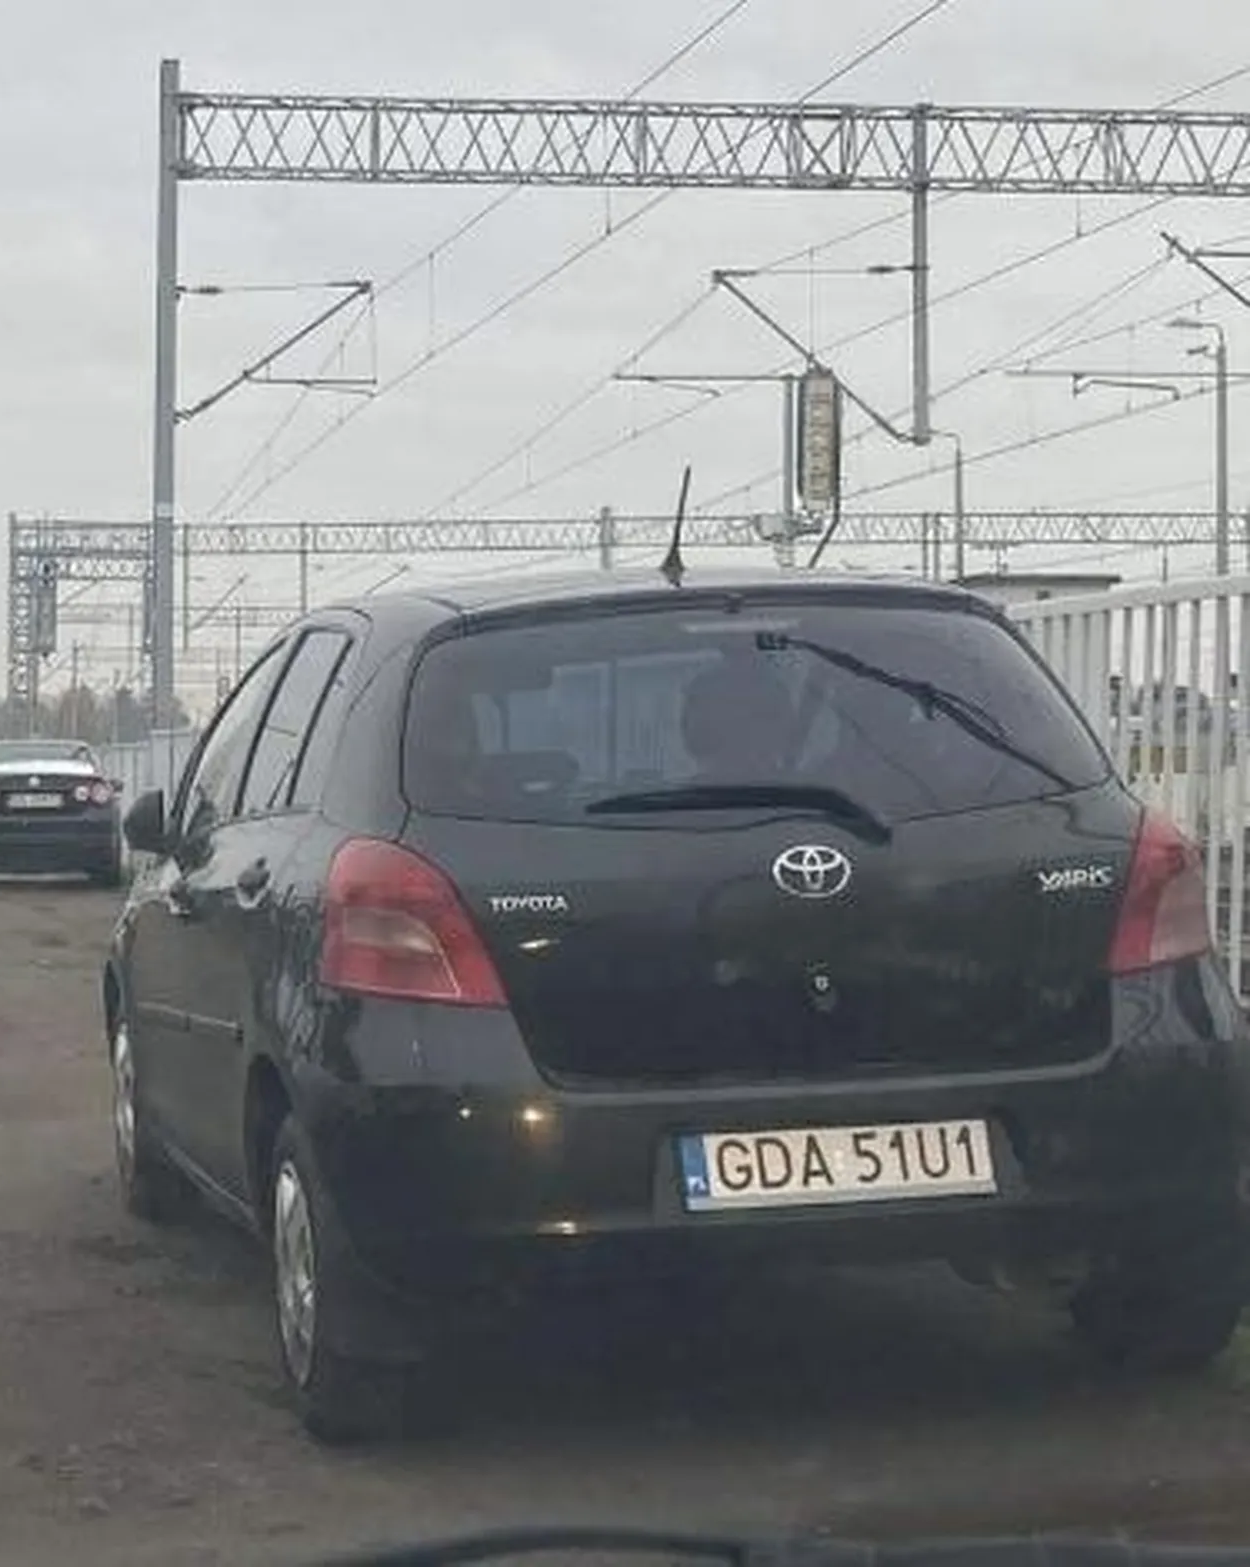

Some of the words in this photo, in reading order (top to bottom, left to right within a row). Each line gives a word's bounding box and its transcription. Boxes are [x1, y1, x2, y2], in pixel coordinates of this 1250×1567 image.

[490, 895, 569, 912] TOYOTA
[715, 1134, 835, 1191] GDA
[851, 1125, 978, 1183] 51U1
